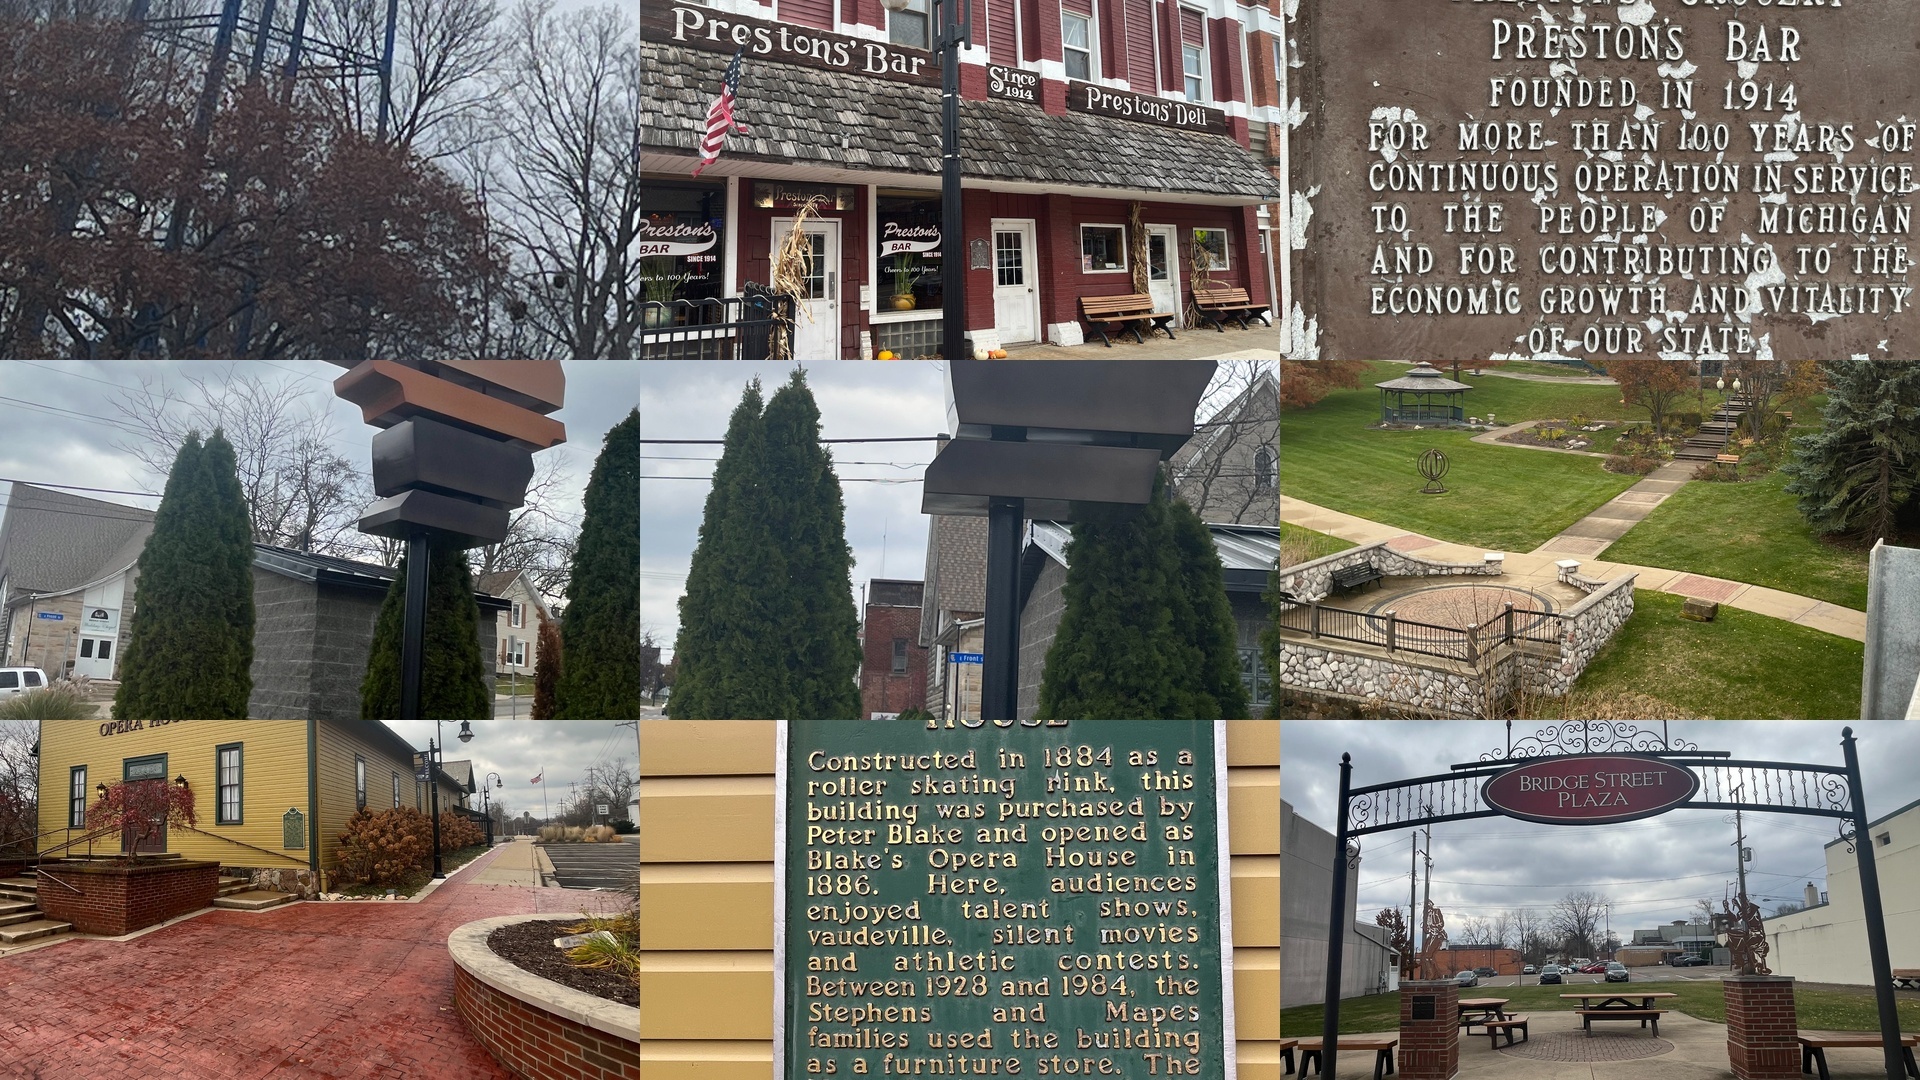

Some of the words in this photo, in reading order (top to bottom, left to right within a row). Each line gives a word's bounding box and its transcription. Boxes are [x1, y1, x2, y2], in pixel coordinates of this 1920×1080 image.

[671, 7, 857, 67] Prestons'
[861, 43, 926, 76] Bar
[1492, 18, 1684, 61] PRESTON'S
[1725, 20, 1801, 62] BAR
[989, 66, 1036, 93] Since
[1004, 86, 1034, 101] 1914
[1085, 86, 1173, 122] Prestons'
[1176, 103, 1207, 126] Deli
[1490, 78, 1636, 109] FOUNDED
[1662, 79, 1693, 110] IN
[1723, 80, 1798, 111] 1914
[1368, 121, 1430, 152] FOR
[1458, 121, 1544, 151] MORE
[1571, 121, 1659, 151] THAN
[1679, 122, 1729, 151] 100
[1750, 123, 1854, 153] YEARS
[1882, 123, 1917, 153] OF
[1369, 162, 1558, 192] CONTINUOUS
[1574, 163, 1739, 193] OPERATION
[1753, 164, 1781, 193] IN
[1794, 164, 1913, 194] SERVICE
[884, 222, 940, 238] Preston's
[1371, 205, 1407, 234] TO
[1443, 205, 1503, 233] THE
[1539, 205, 1655, 234] PEOPLE
[1690, 205, 1725, 234] OF
[1759, 204, 1911, 234] MICHIGAN
[640, 244, 670, 255] BAR
[891, 243, 911, 251] BAR
[1371, 245, 1433, 274] AND
[1460, 246, 1516, 274] FOR
[1541, 246, 1771, 274] CONTRIBUTING
[1798, 247, 1831, 274] TO
[1852, 246, 1908, 274] THE
[683, 272, 710, 283] Years!
[1371, 286, 1521, 315] ECONOMIC
[1540, 286, 1665, 315] GROWTH
[1690, 286, 1750, 315] AND
[1768, 285, 1907, 314] VITALITY
[1528, 326, 1564, 354] OF
[1583, 327, 1643, 354] OUR
[1662, 327, 1751, 354] STATE
[100, 720, 143, 736] OPERA
[807, 749, 976, 771] Constructed
[998, 747, 1025, 768] in
[1044, 744, 1112, 767] 1884
[1128, 750, 1158, 766] as
[1177, 750, 1193, 765] a
[807, 776, 887, 796] roller
[910, 773, 1016, 799] skating
[1047, 770, 1115, 794] rink,
[1140, 769, 1194, 791] this
[1519, 774, 1590, 792] BRIDGE
[1594, 770, 1668, 789] STREET
[807, 801, 918, 825] building
[935, 802, 985, 819] was
[998, 796, 1144, 821] purchased
[1159, 795, 1194, 821] by
[1558, 791, 1629, 809] PLAZA
[806, 825, 876, 846] Peter
[887, 823, 962, 845] Blake
[976, 823, 1028, 843] and
[1041, 821, 1148, 846] opened
[1165, 824, 1194, 841] as
[807, 847, 903, 870] Blake's
[928, 848, 1018, 872] Opera
[1045, 846, 1136, 867] House
[1167, 845, 1196, 866] in
[807, 873, 879, 896] 1886.
[927, 873, 1006, 895] Here,
[1050, 871, 1197, 893] audiences
[806, 900, 921, 925] enjoyed
[961, 898, 1050, 919] talent
[1100, 896, 1197, 918] shows,
[807, 924, 953, 946] vaudeville,
[993, 923, 1074, 944] silent
[1100, 922, 1199, 944] movies
[807, 951, 858, 972] and
[894, 949, 1015, 972] athletic
[1058, 950, 1199, 971] contests.
[806, 975, 916, 997] Between
[926, 973, 988, 997] 1928
[1001, 977, 1050, 996] and
[1062, 973, 1135, 998] 1984,
[1154, 974, 1200, 996] the
[808, 1001, 931, 1026] Stephens
[992, 1002, 1046, 1023] and
[1106, 1000, 1200, 1028] Mapes
[807, 1025, 909, 1049] families
[927, 1027, 993, 1049] used
[1010, 1028, 1059, 1049] the
[1077, 1027, 1200, 1052] building
[806, 1057, 836, 1073] as
[853, 1057, 868, 1074] a
[883, 1052, 1021, 1074] furniture
[1038, 1054, 1121, 1075] store.
[1143, 1052, 1200, 1075] The
